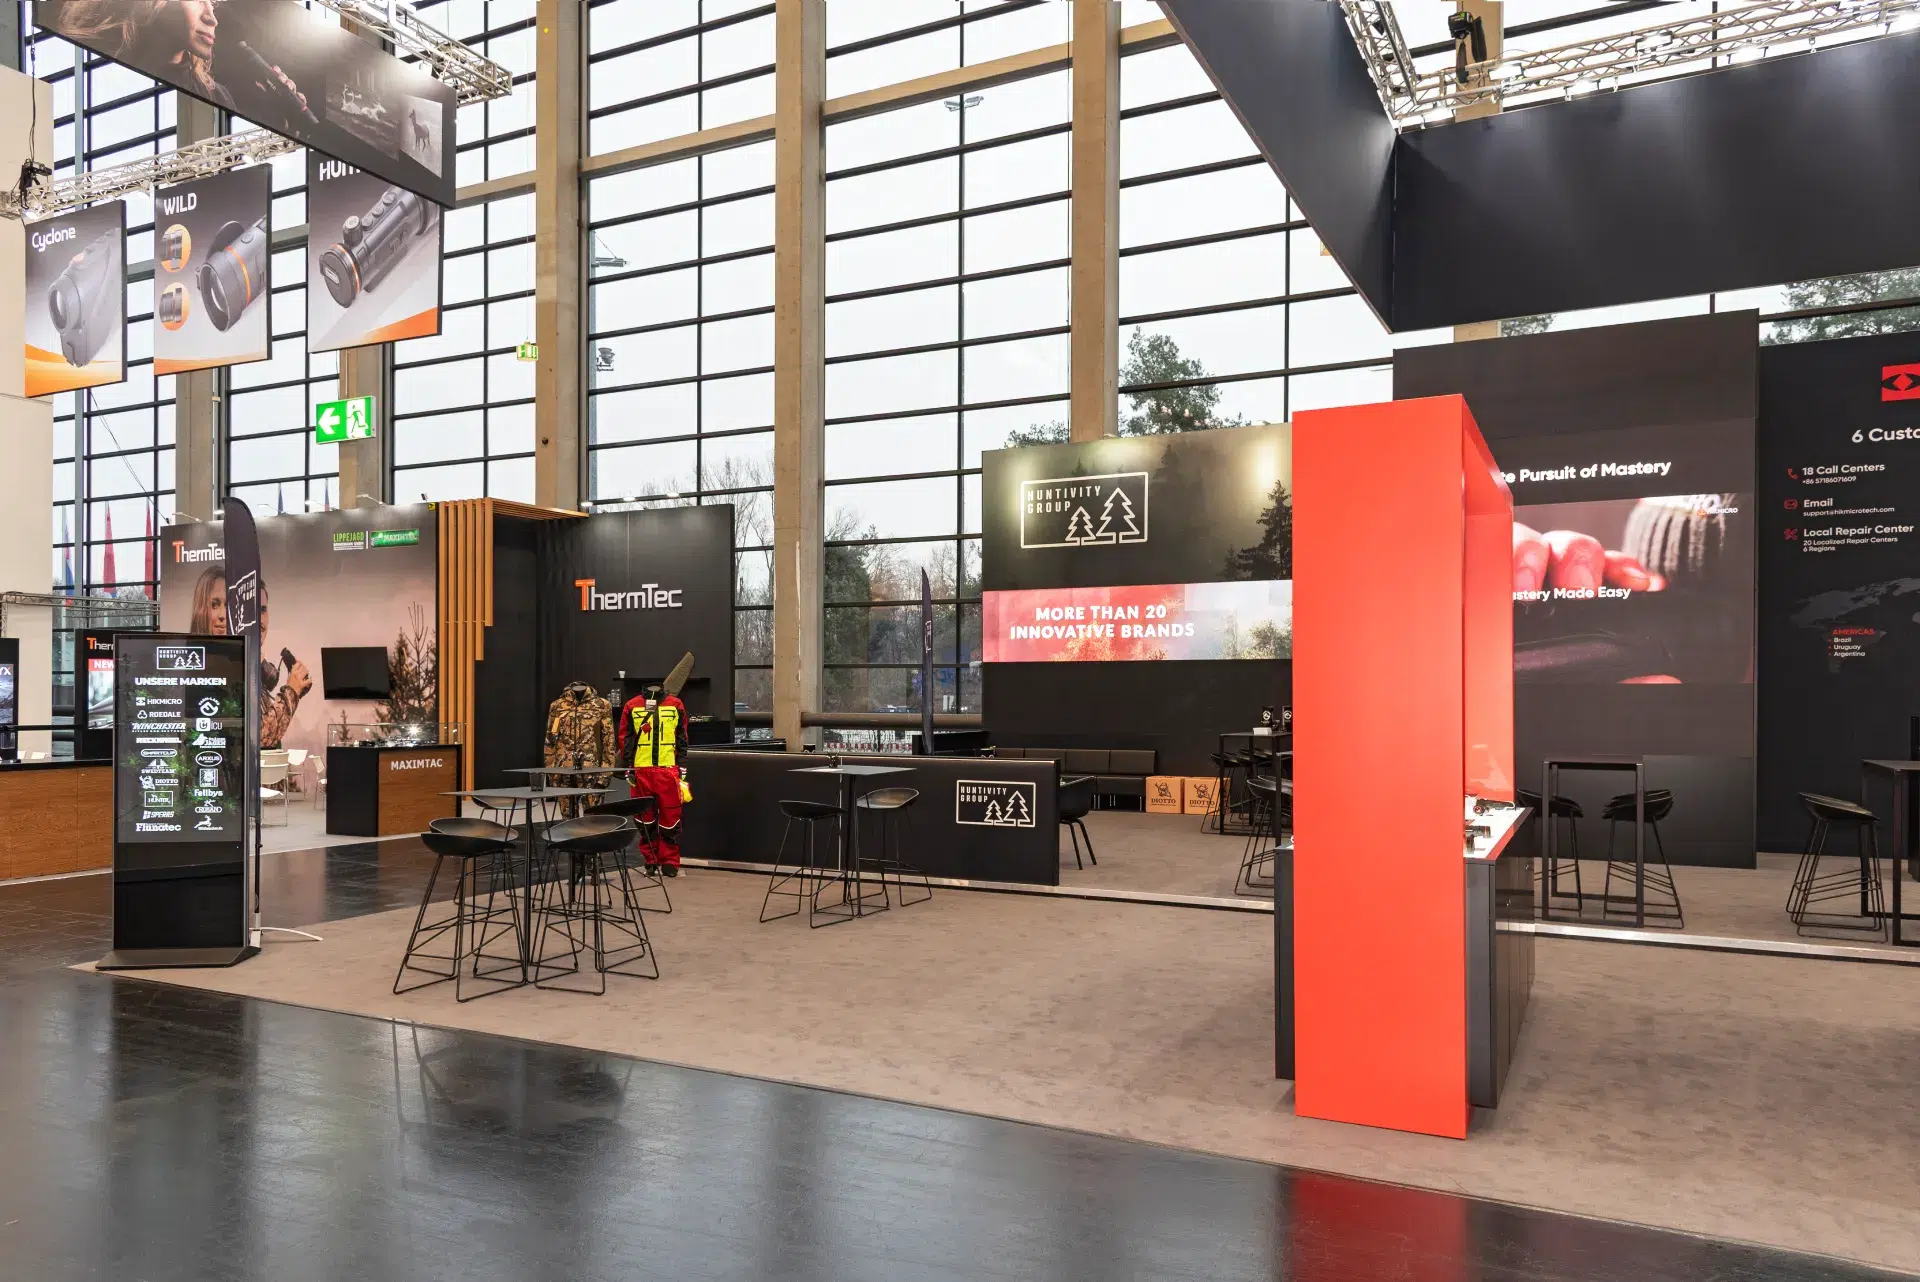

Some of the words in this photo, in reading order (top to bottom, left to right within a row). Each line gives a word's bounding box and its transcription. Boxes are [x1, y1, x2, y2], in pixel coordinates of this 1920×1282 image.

[163, 193, 197, 216] WILD
[31, 226, 76, 252] Cyclone
[1851, 429, 1864, 443] 6
[1519, 465, 1577, 483] Pursuit
[1580, 463, 1598, 479] of
[1601, 461, 1672, 477] Mastery
[1802, 466, 1814, 476] 18
[1816, 465, 1839, 475] Call
[1841, 464, 1886, 473] Centers
[1027, 485, 1101, 501] HUNTIVITY
[1027, 501, 1071, 514] GROUP
[1803, 498, 1834, 508] Email
[1803, 507, 1895, 517] support@hikmicrotech.com
[1803, 527, 1833, 537] Local
[1835, 526, 1872, 537] Repair
[1874, 524, 1915, 534] Center
[1813, 538, 1846, 546] Localized
[1846, 537, 1869, 545] Repair
[1808, 545, 1836, 553] Regions
[575, 579, 683, 611] ThermTec
[1553, 586, 1595, 599] Made
[1597, 586, 1632, 600] Easy
[1035, 606, 1085, 621] MORE
[1090, 605, 1139, 620] THAN
[1145, 605, 1167, 619] 20
[1010, 624, 1115, 640] INNOVATIVE
[1121, 622, 1195, 639] BRANDS
[134, 677, 178, 686] UNSERE
[179, 677, 227, 686] MARKEN
[131, 722, 187, 730] WINCHESTER
[391, 758, 443, 771] MAXIMTAC
[960, 786, 1007, 795] HUNTIVITY
[960, 794, 988, 803] GROUP
